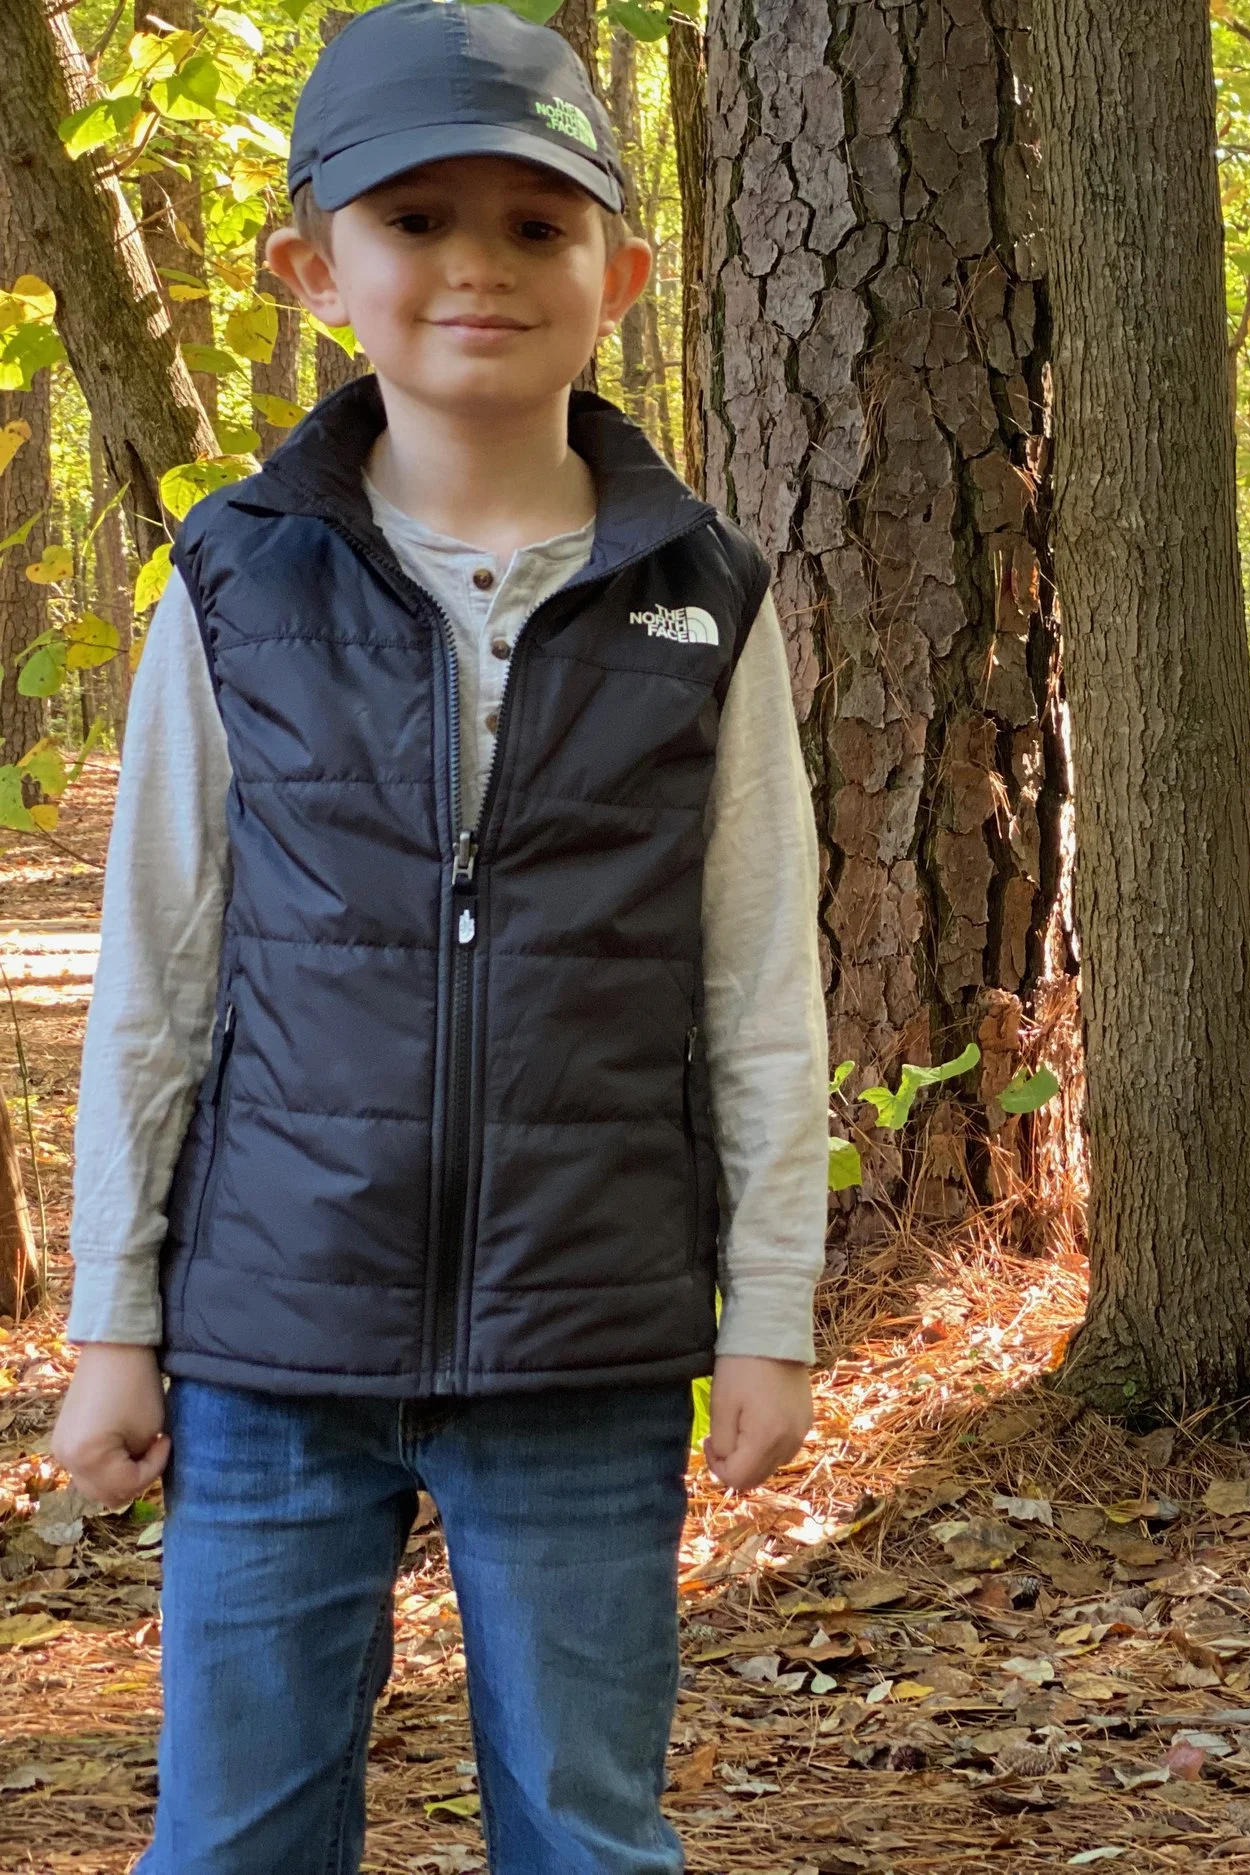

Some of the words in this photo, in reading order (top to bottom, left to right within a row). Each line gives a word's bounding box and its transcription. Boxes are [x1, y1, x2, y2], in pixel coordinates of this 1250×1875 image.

[655, 603, 685, 620] THE
[630, 611, 687, 632] NORTH
[648, 624, 688, 643] FACE
